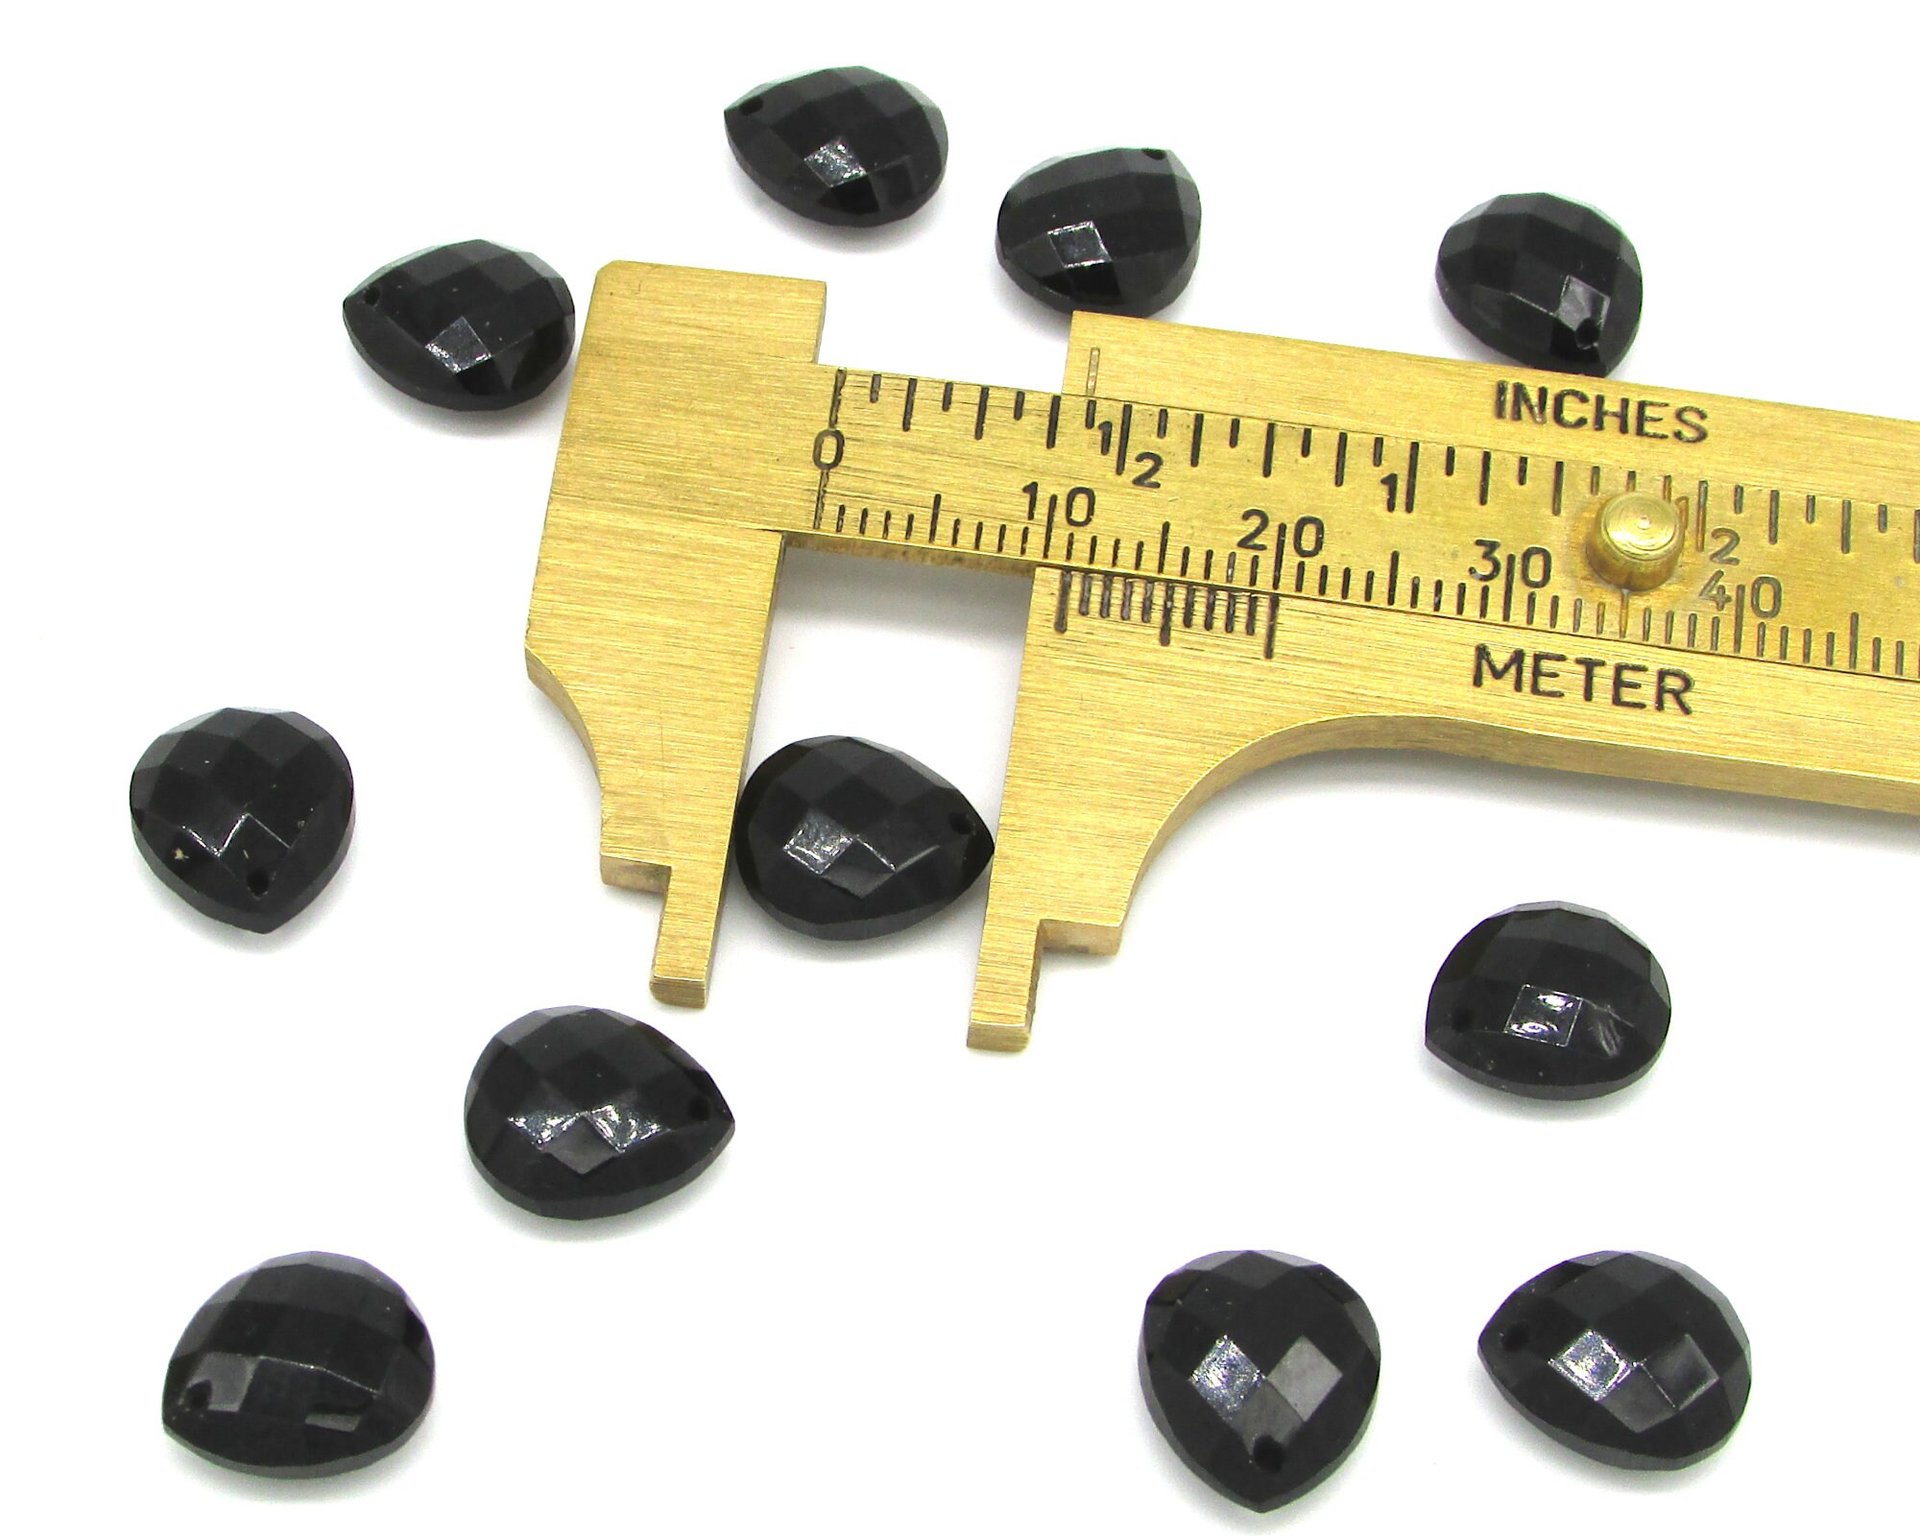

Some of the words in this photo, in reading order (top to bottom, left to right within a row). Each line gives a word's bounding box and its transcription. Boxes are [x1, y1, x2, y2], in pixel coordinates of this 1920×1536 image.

[1495, 380, 1709, 443] INCHES
[812, 428, 846, 471] 0
[1472, 643, 1696, 714] METER
